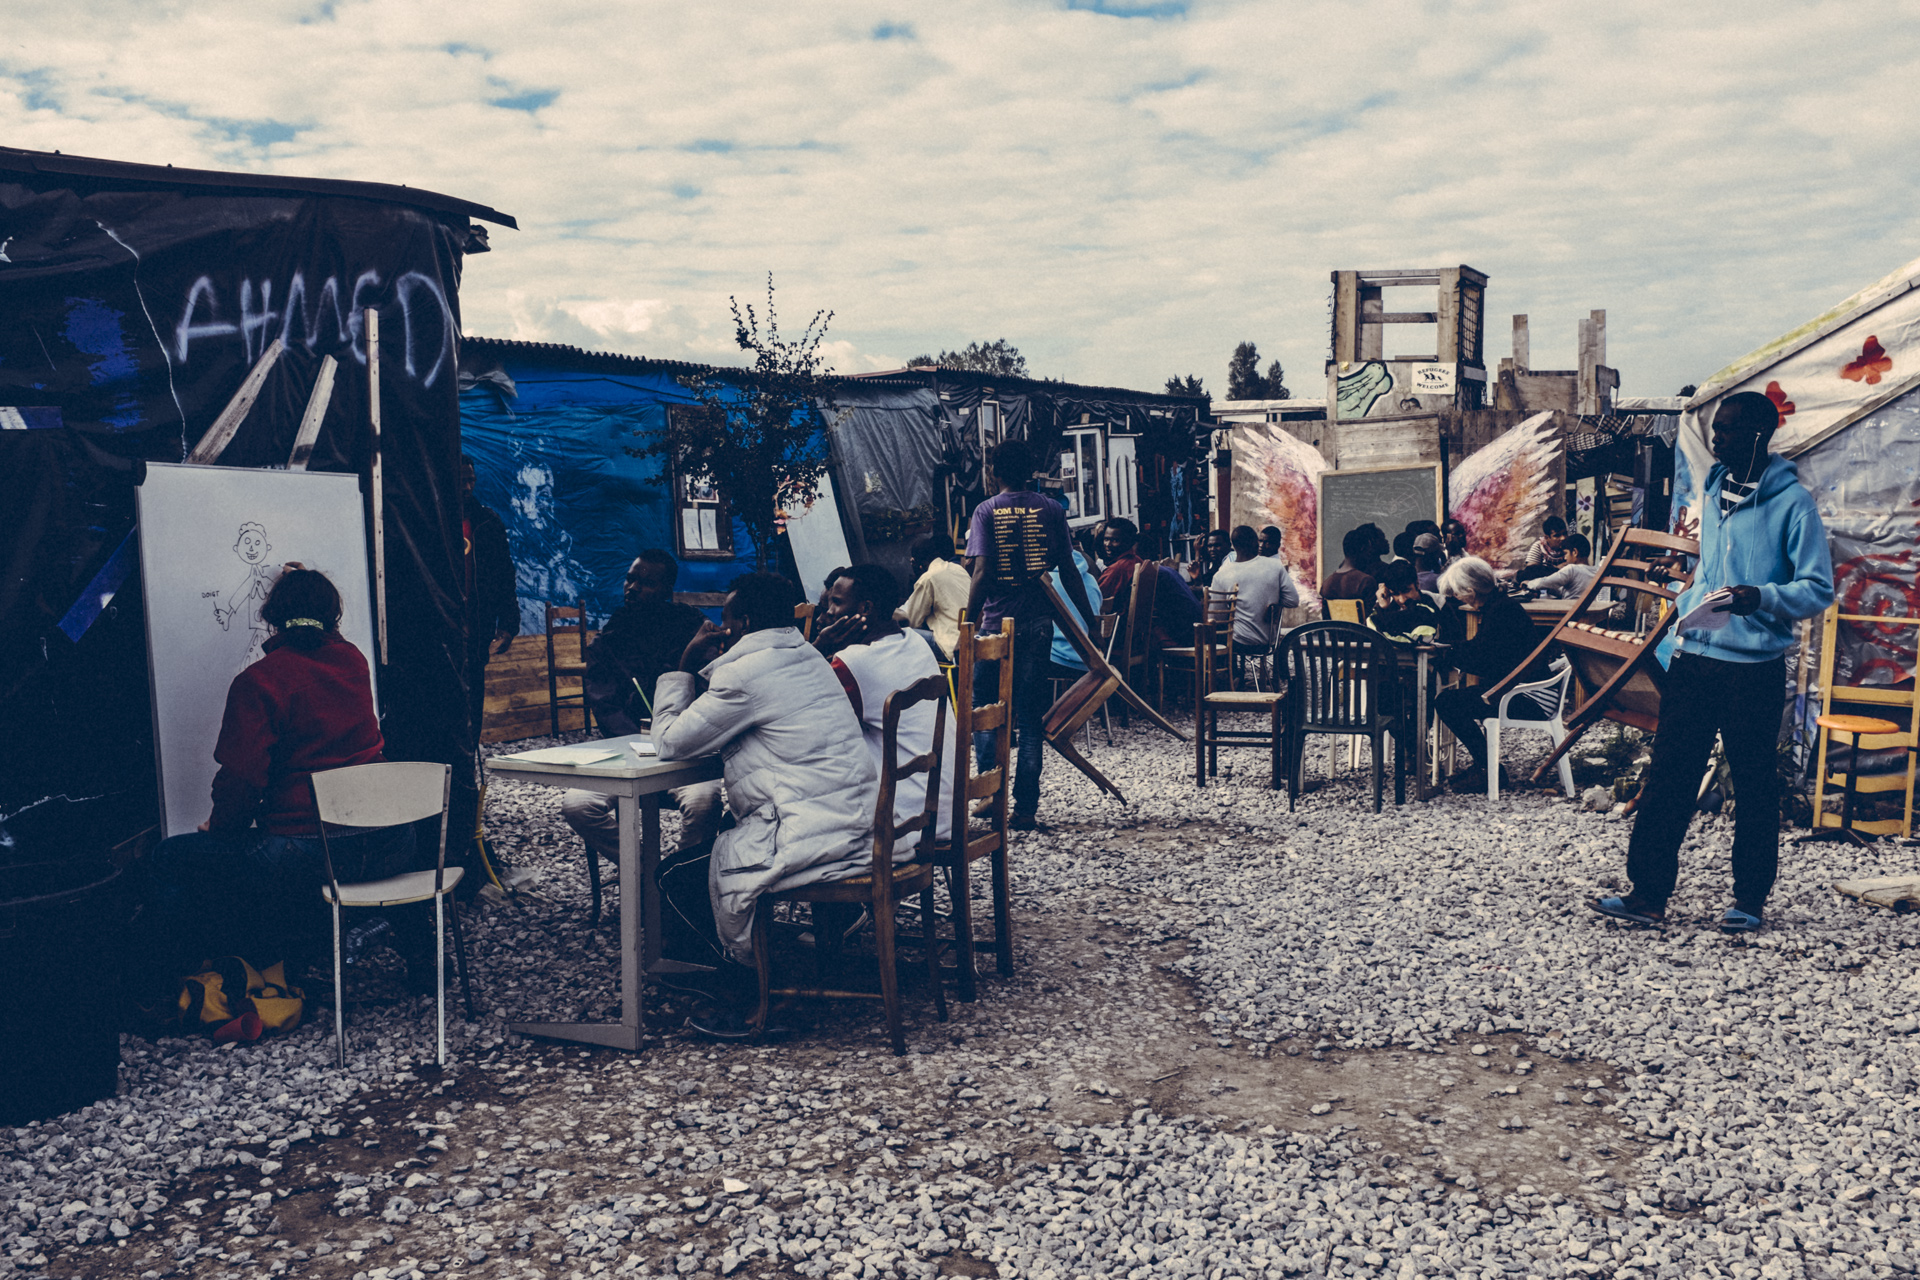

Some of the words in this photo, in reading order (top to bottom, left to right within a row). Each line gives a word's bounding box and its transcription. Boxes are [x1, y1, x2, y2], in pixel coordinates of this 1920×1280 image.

[175, 269, 453, 388] AHMED
[1417, 367, 1450, 375] REFUGEES
[1416, 382, 1449, 390] WELCOME
